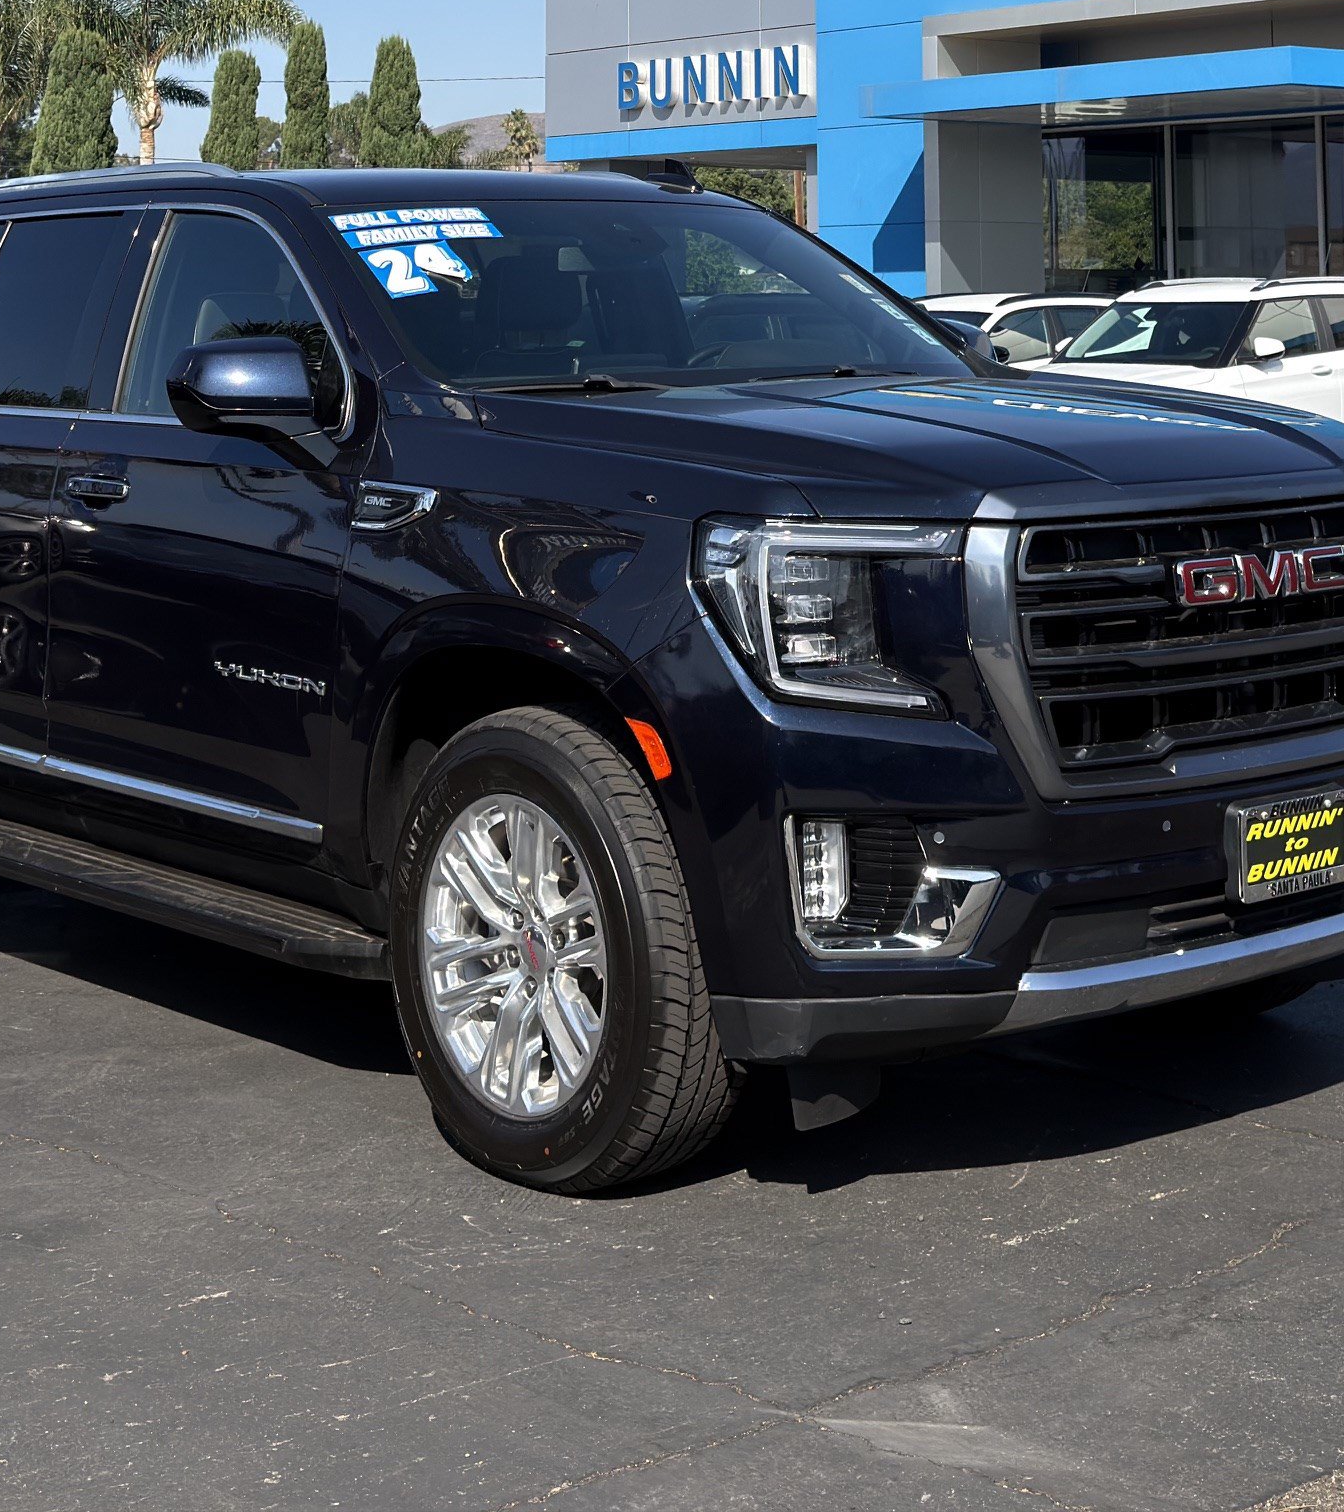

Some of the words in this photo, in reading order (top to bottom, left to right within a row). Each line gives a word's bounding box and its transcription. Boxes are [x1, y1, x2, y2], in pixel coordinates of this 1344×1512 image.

[617, 44, 803, 111] BUNNIN
[334, 211, 397, 230] FULL
[396, 207, 485, 223] POWER
[356, 224, 438, 246] FAMILY
[439, 223, 494, 238] SIZE
[364, 495, 393, 508] GMC
[214, 660, 326, 697] YUKON
[1270, 794, 1325, 817] BUNNIN
[1245, 807, 1344, 842] RUNNIN'
[1284, 837, 1309, 852] to
[1247, 846, 1339, 883] BUNNIN
[1270, 878, 1300, 897] SANTA
[1302, 870, 1332, 890] PAULA
